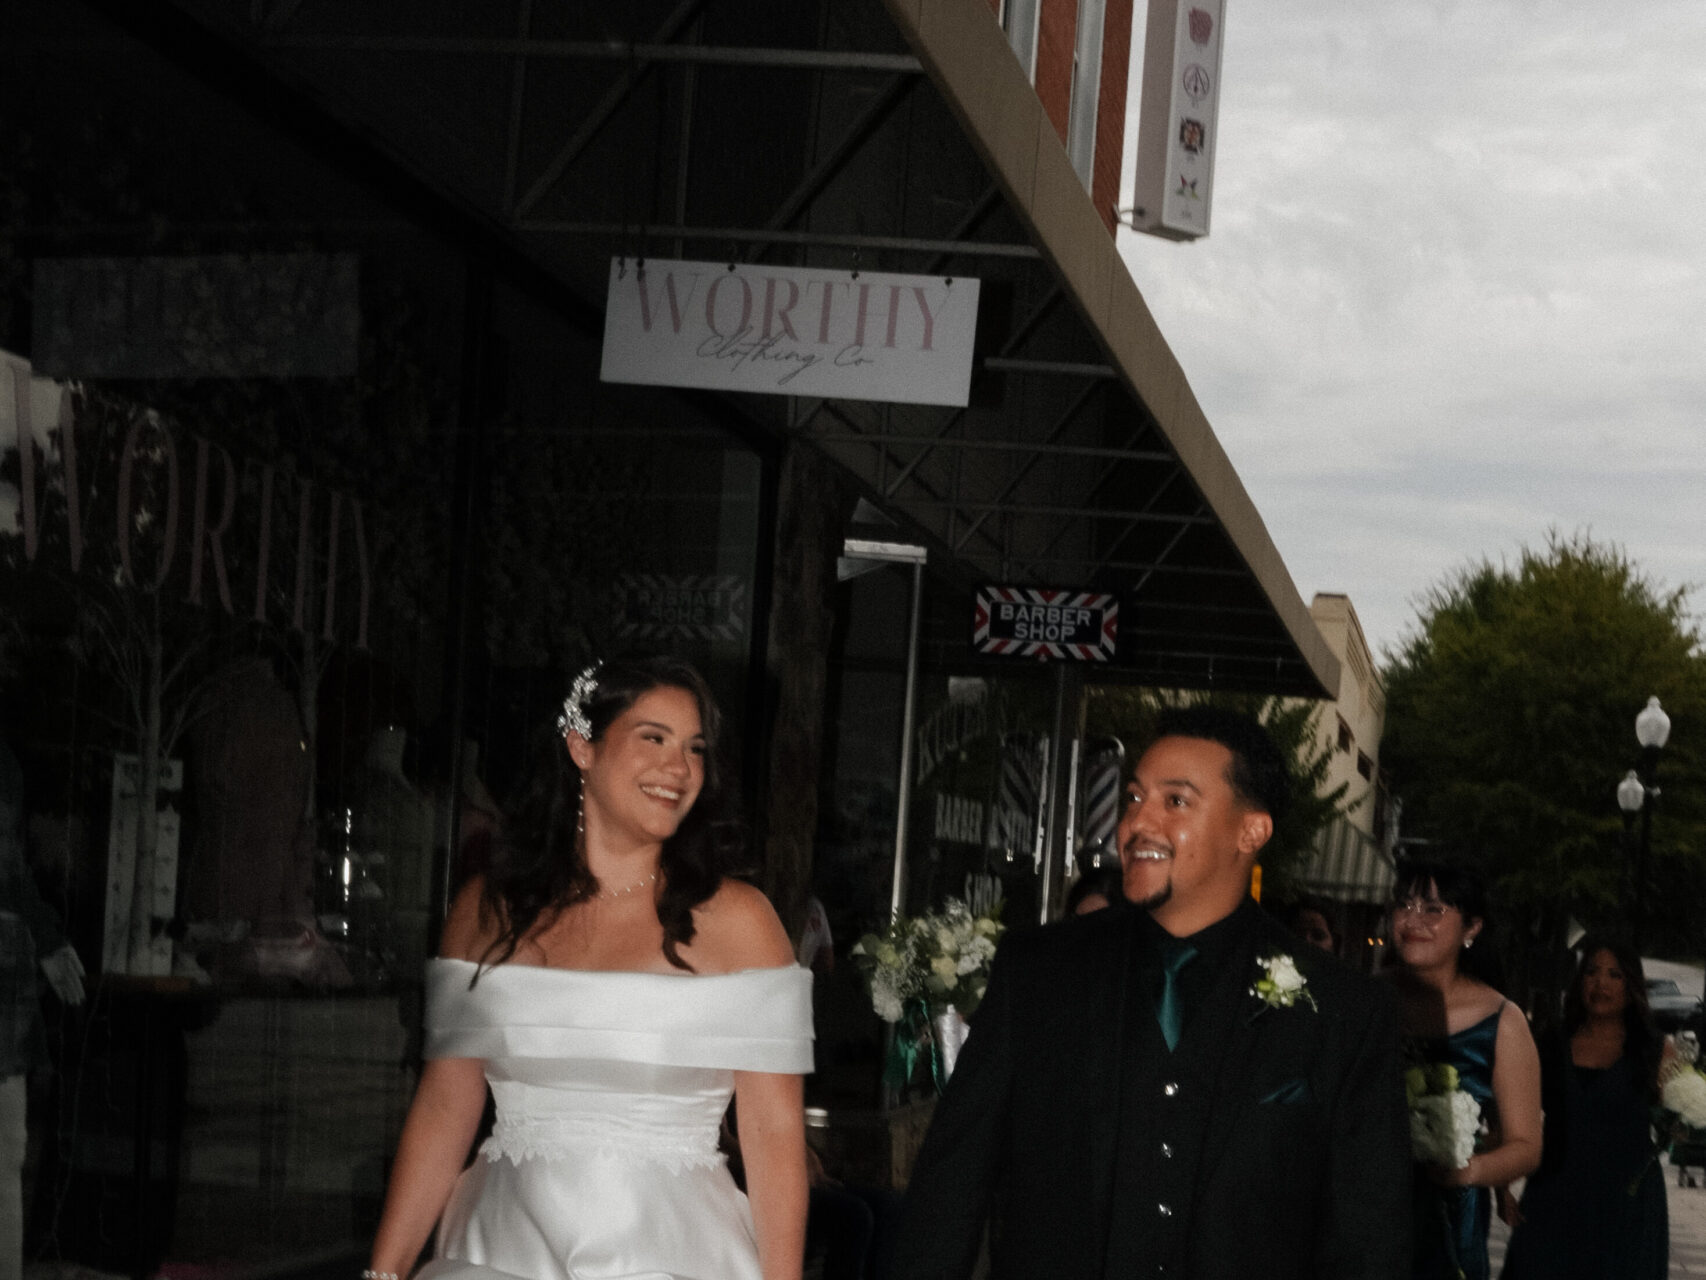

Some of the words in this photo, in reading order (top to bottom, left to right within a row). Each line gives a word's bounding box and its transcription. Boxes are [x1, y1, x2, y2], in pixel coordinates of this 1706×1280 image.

[632, 267, 956, 351] WORTHY
[697, 325, 825, 385] Clothing
[834, 344, 874, 368] Co
[1000, 604, 1092, 627] BARBER
[1014, 622, 1076, 643] SHOP
